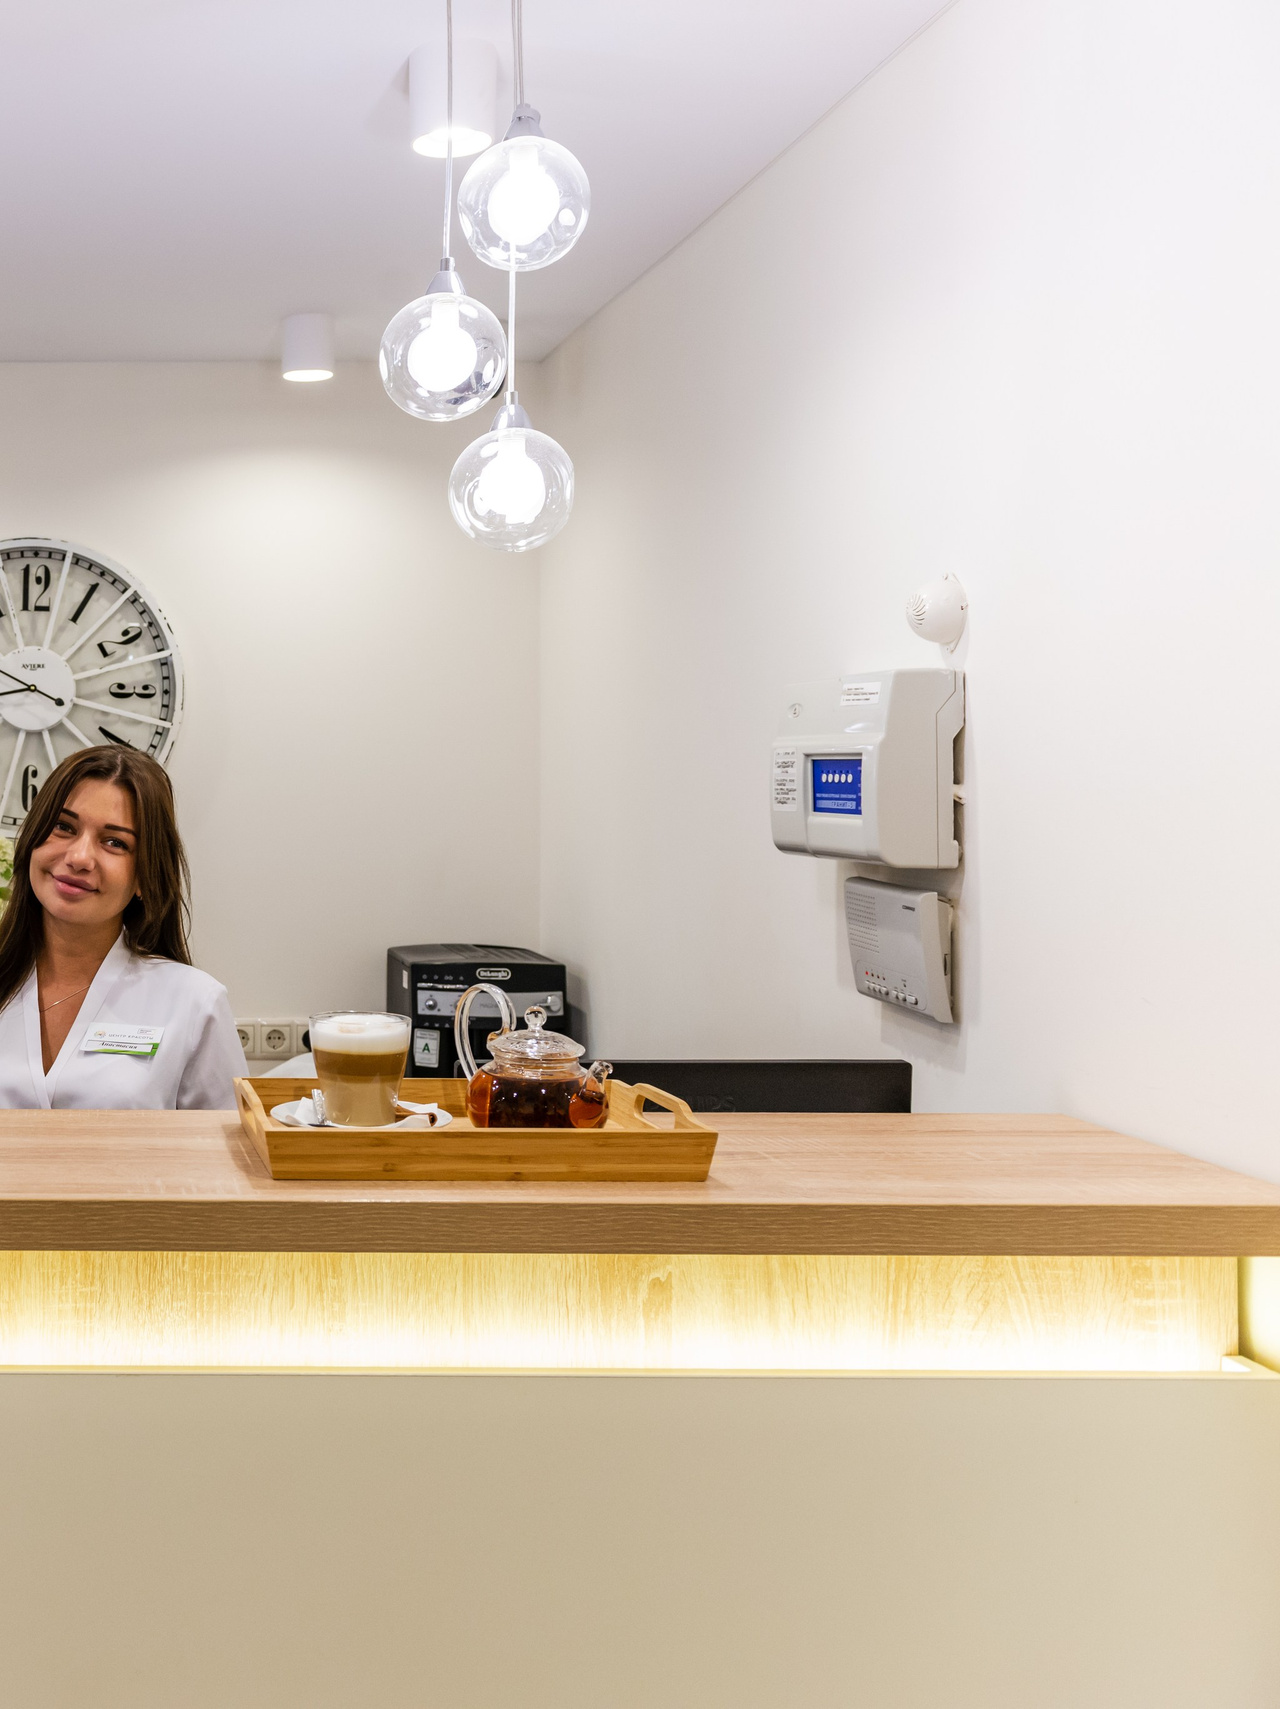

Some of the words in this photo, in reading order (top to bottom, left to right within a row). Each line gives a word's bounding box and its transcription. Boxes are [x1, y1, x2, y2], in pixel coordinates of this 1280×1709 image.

[20, 563, 51, 612] 12
[69, 582, 100, 625] 1
[97, 626, 143, 658] 2
[108, 682, 157, 699] 3
[422, 1042, 431, 1053] A
